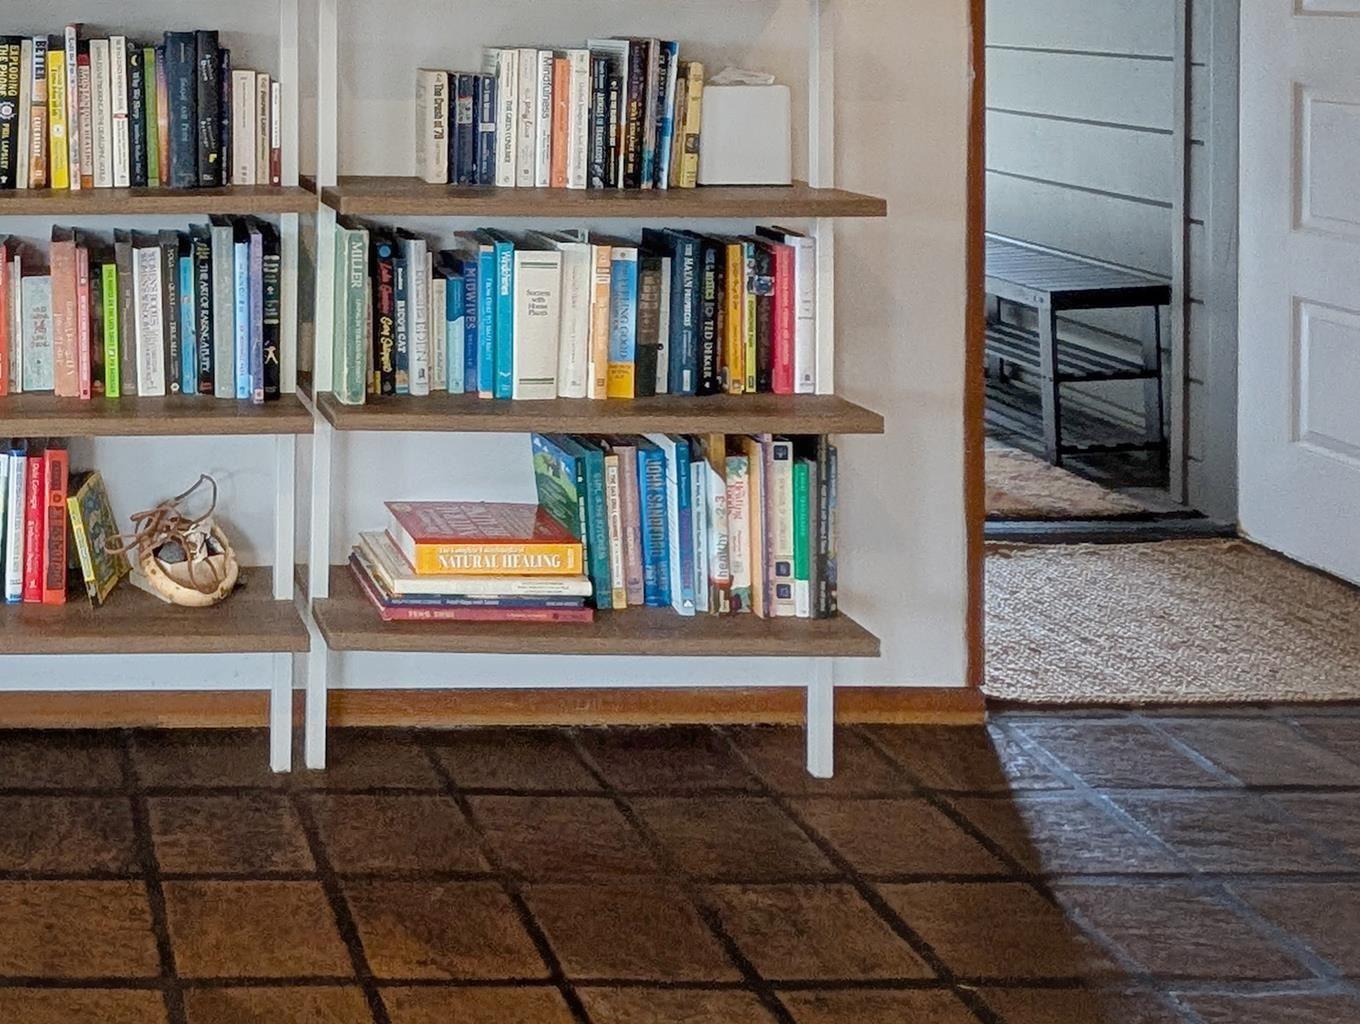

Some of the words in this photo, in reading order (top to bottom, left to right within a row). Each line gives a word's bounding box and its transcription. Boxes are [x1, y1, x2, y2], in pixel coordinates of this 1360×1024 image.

[8, 44, 20, 97] EXPLODING
[434, 84, 443, 96] The
[541, 56, 552, 119] Mindfulness
[2, 123, 10, 139] PHIL
[351, 241, 363, 288] MILLER
[200, 281, 209, 296] ART
[200, 296, 210, 309] OF
[466, 267, 476, 329] MIDWIVES
[200, 309, 209, 340] RAISING
[704, 320, 713, 339] TED
[620, 326, 629, 358] GOOD
[646, 458, 662, 490] JOHN
[648, 494, 665, 558] SANDFORD
[439, 555, 499, 568] NATURAL
[502, 555, 561, 568] HEALING
